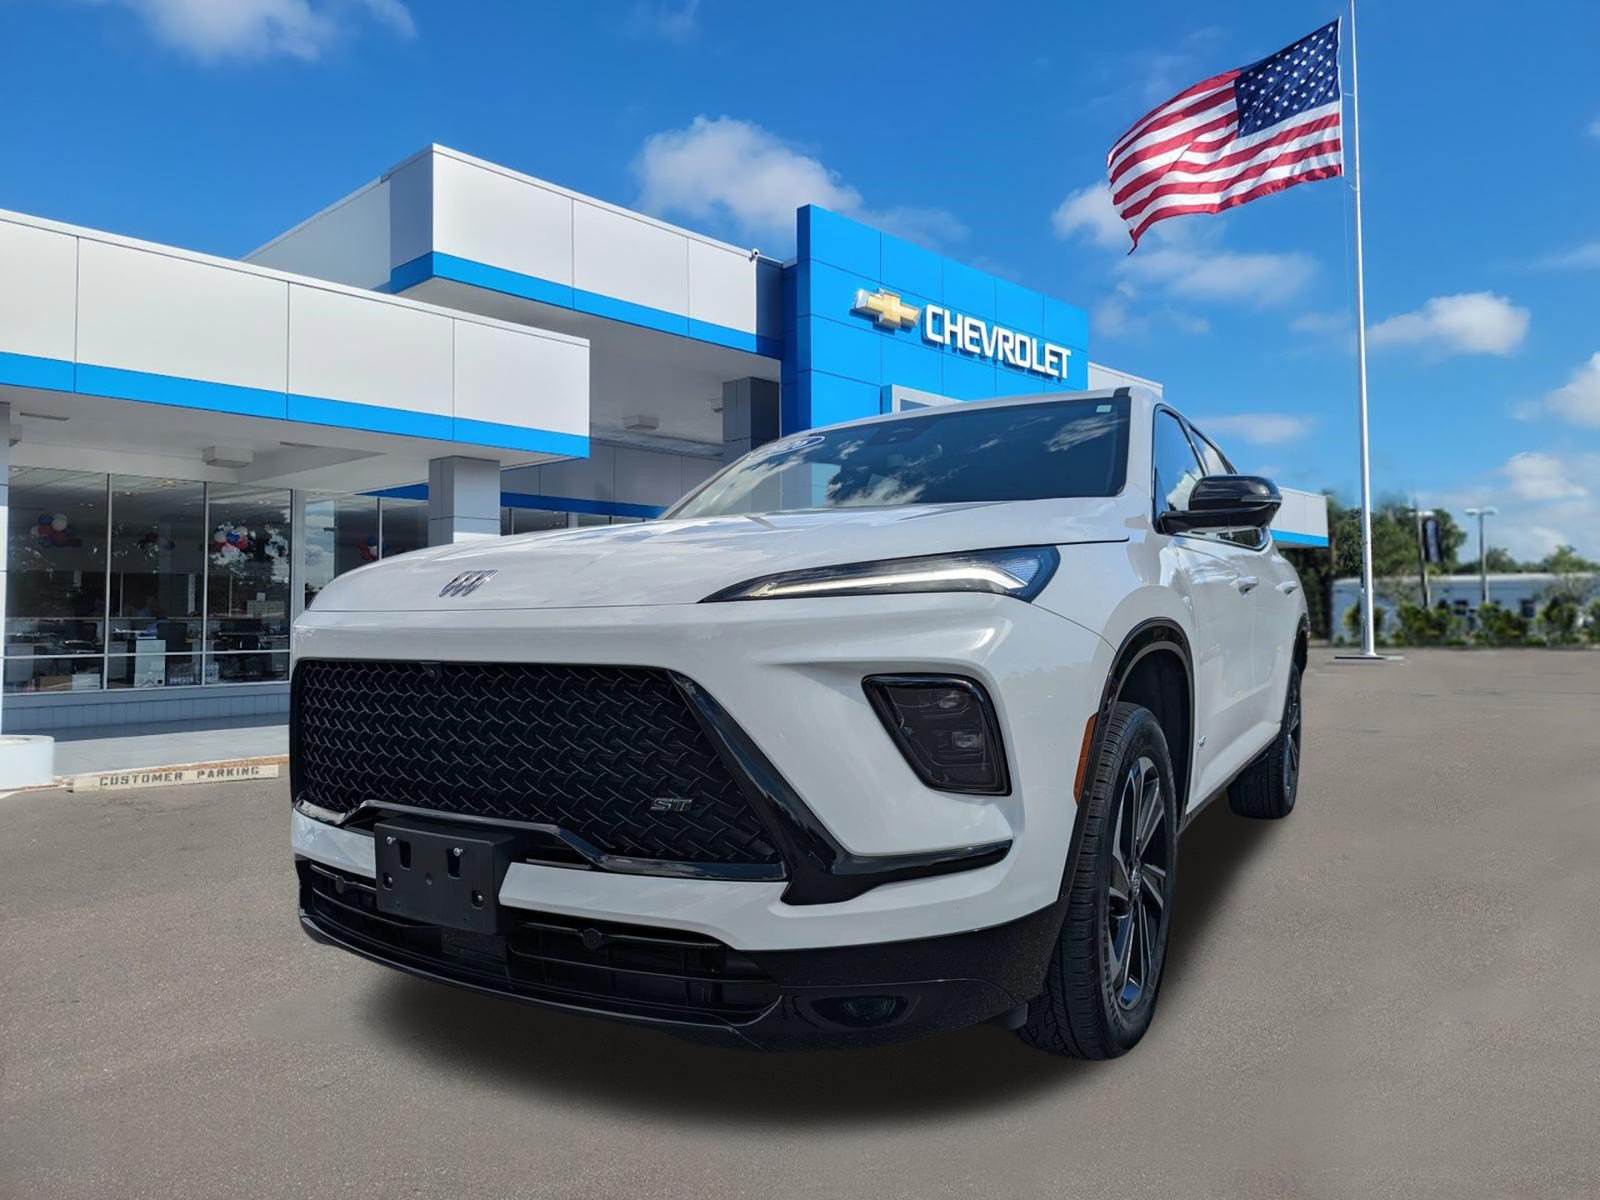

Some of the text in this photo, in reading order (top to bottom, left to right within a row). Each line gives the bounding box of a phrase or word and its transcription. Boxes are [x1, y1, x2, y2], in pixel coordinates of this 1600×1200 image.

[925, 303, 1072, 379] CHEVROLET
[99, 766, 259, 786] CUSTOMER PARKING
